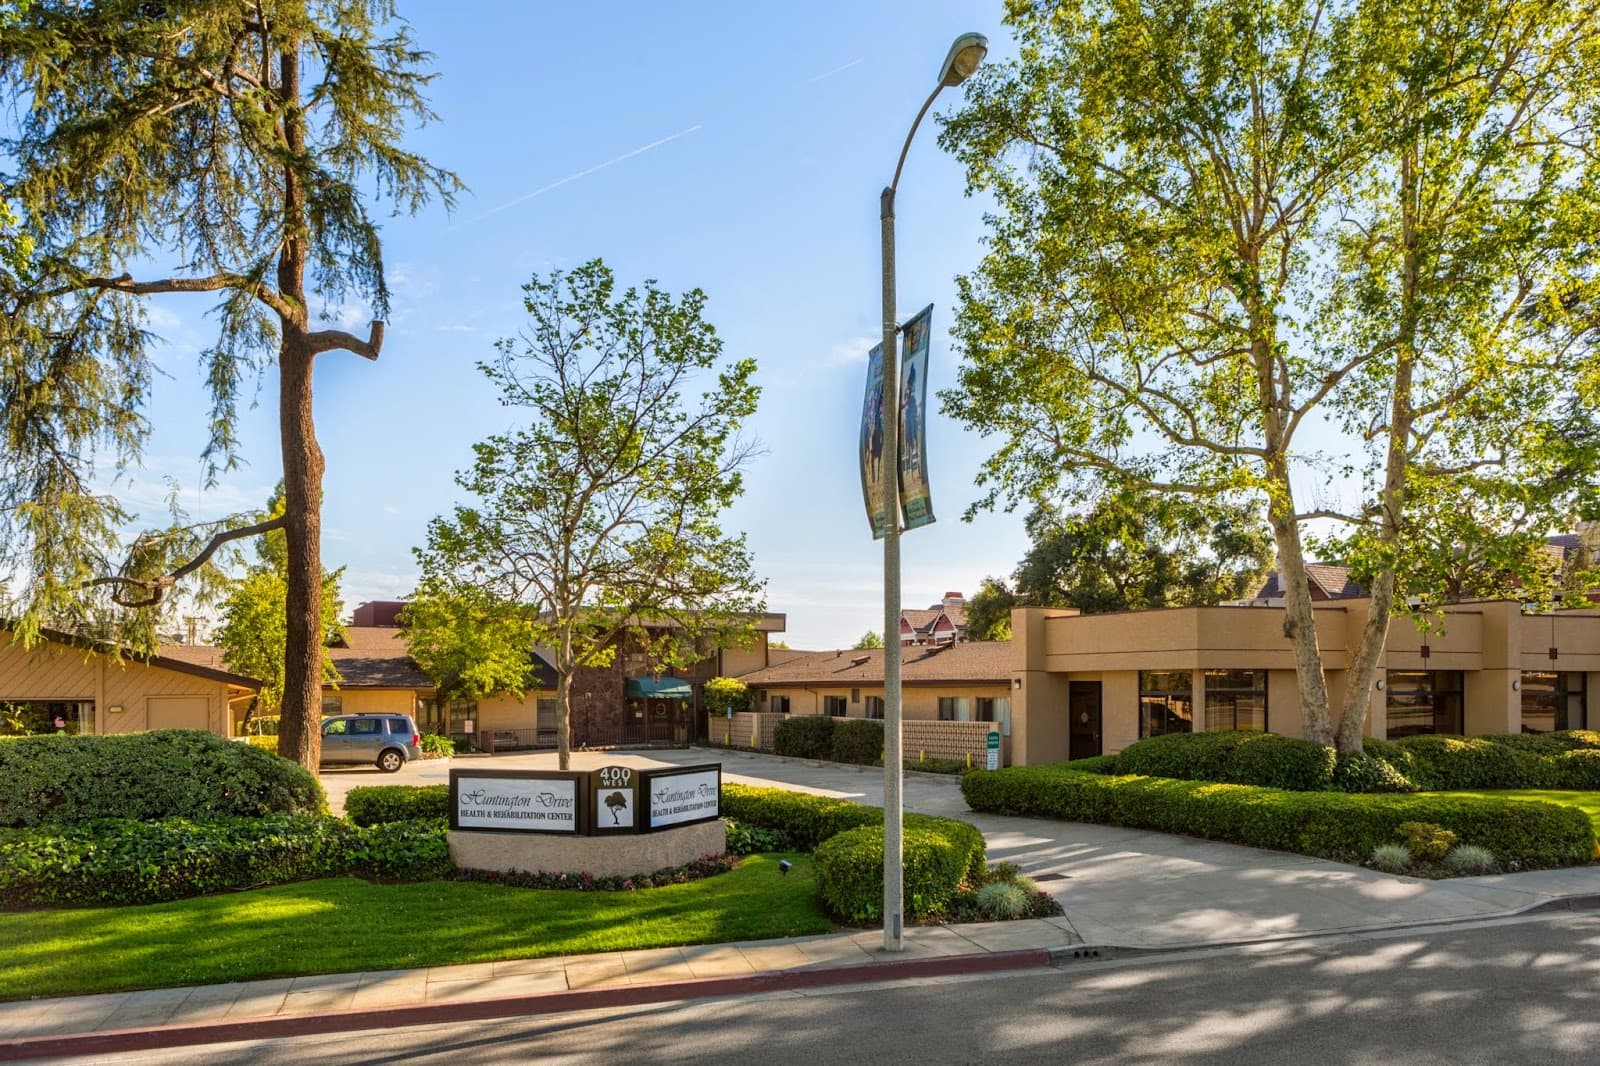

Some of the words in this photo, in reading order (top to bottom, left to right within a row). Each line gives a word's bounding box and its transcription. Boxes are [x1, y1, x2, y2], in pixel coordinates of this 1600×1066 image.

[600, 767, 631, 780] 400
[602, 779, 629, 787] WEST
[460, 788, 531, 810] Huntington
[536, 792, 573, 808] Drive
[652, 786, 696, 805] Huntington
[460, 809, 485, 818] HEALTH
[486, 810, 492, 818] &
[493, 810, 546, 820] REHABILITATION
[547, 812, 573, 821] CENTER
